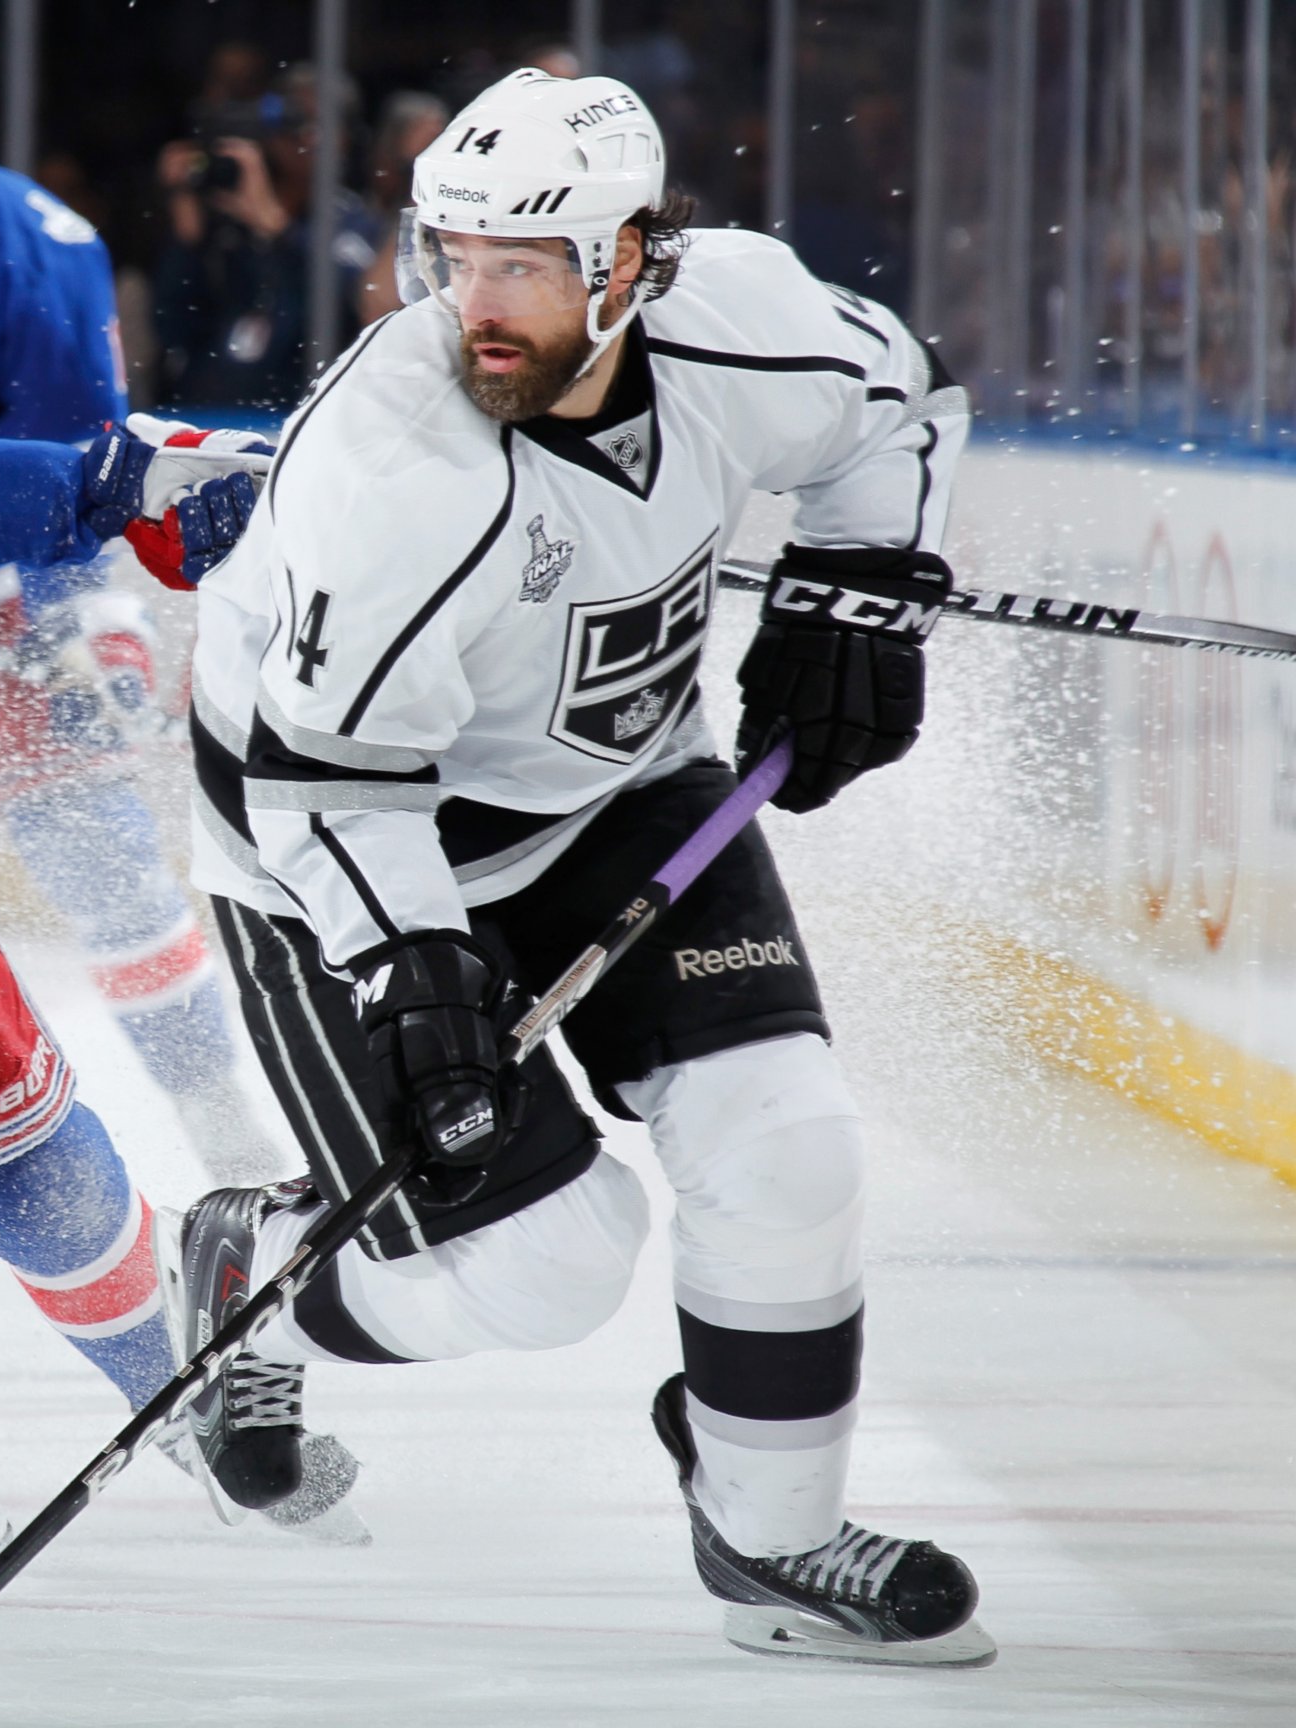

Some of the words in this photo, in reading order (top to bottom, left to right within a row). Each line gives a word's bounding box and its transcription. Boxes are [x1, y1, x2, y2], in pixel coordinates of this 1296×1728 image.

[454, 127, 503, 155] 14
[437, 184, 491, 204] Reebok
[580, 557, 706, 681] LA
[771, 576, 944, 636] CCM
[674, 935, 800, 981] Reebok
[351, 963, 394, 1021] M
[438, 1107, 493, 1143] CCM
